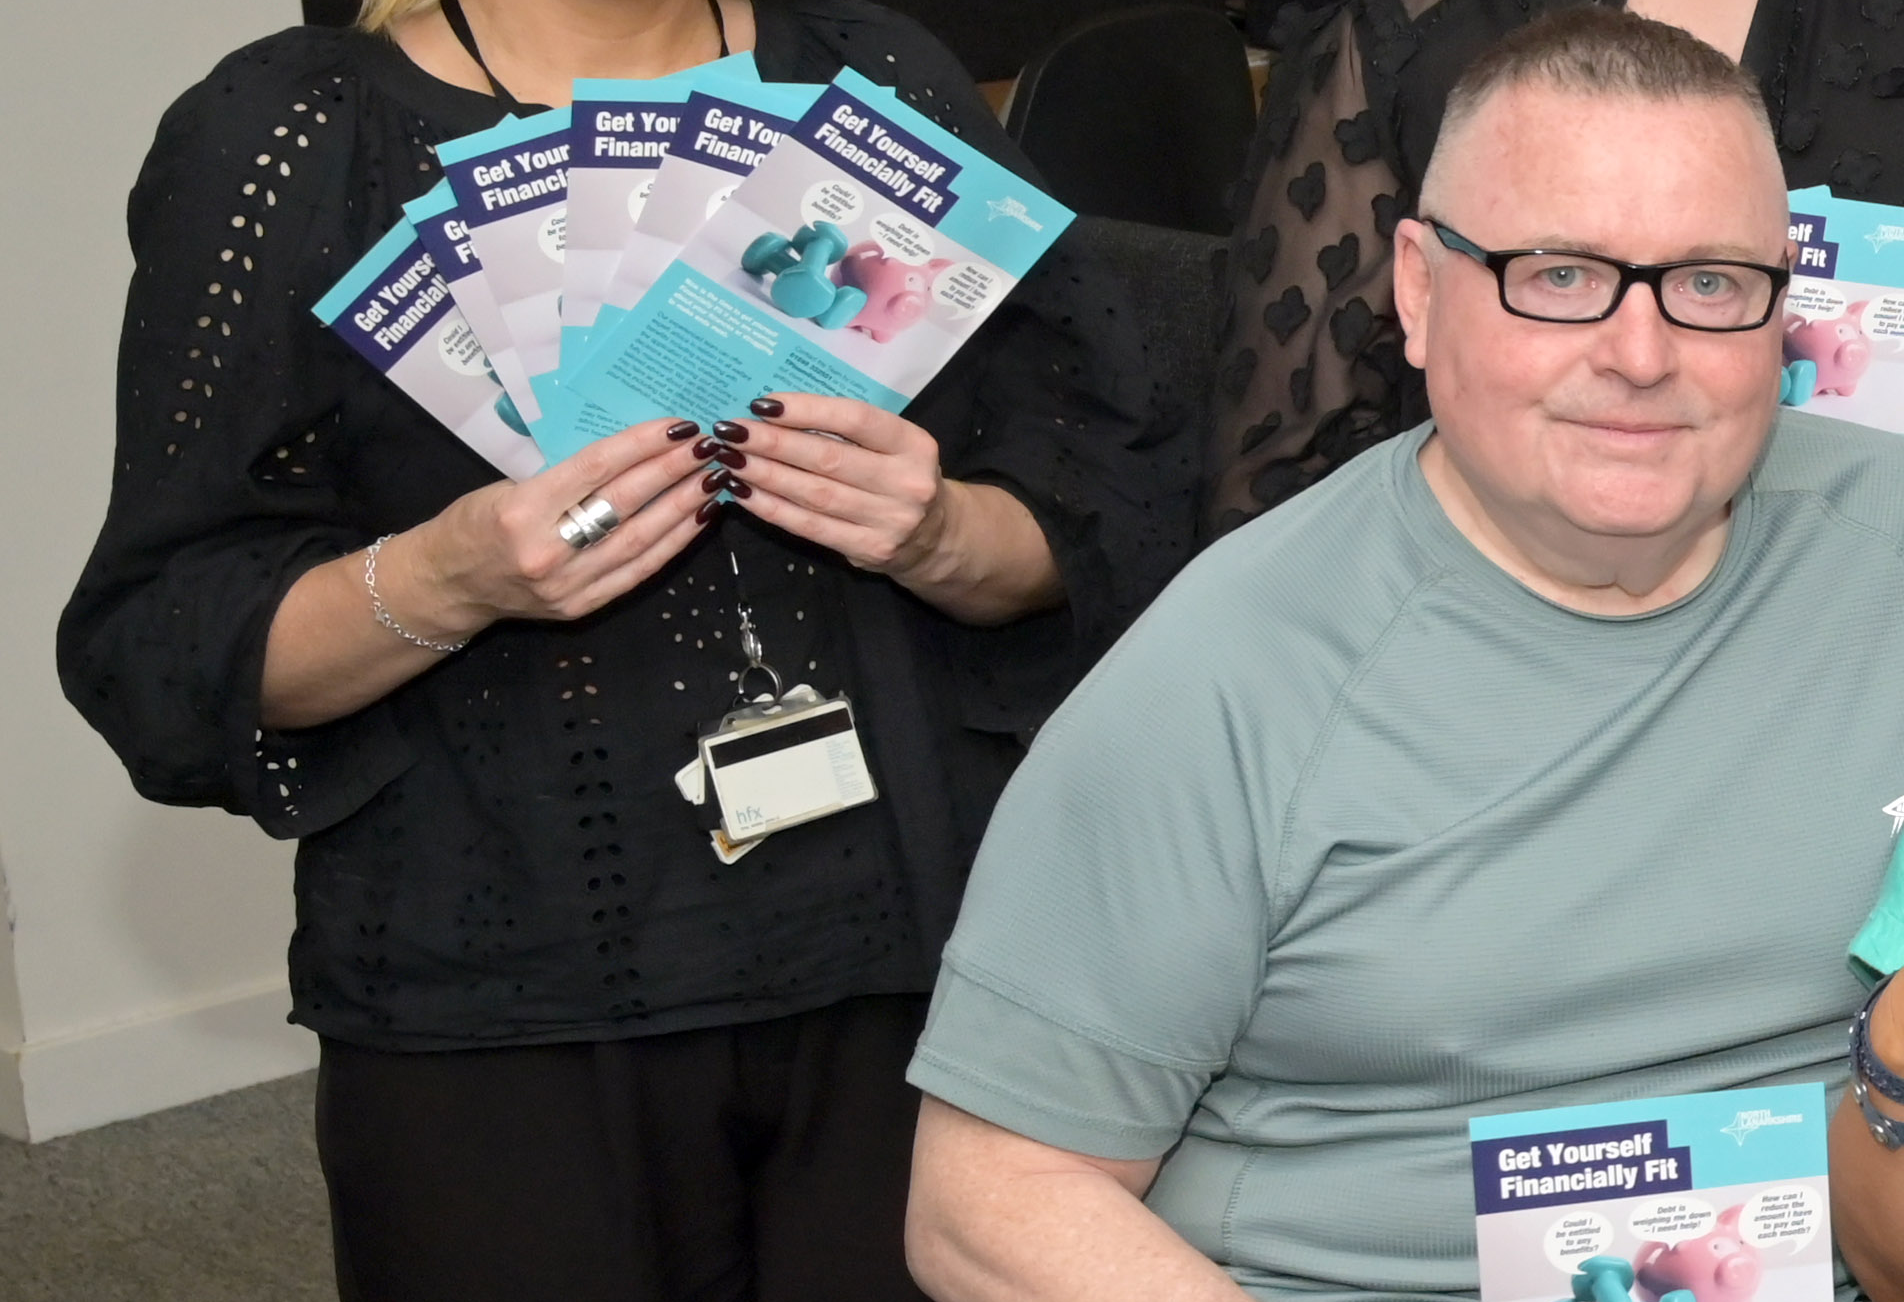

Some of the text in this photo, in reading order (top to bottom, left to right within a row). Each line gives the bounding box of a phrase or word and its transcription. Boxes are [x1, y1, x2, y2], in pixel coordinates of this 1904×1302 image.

[596, 111, 635, 133] Get
[831, 104, 947, 184] Get Yourself
[813, 123, 945, 215] Financially Fit
[1801, 247, 1827, 268] Fit
[354, 298, 389, 333] Get
[1498, 1133, 1653, 1173] Get Yourself
[1501, 1159, 1679, 1199] Financially Fit
